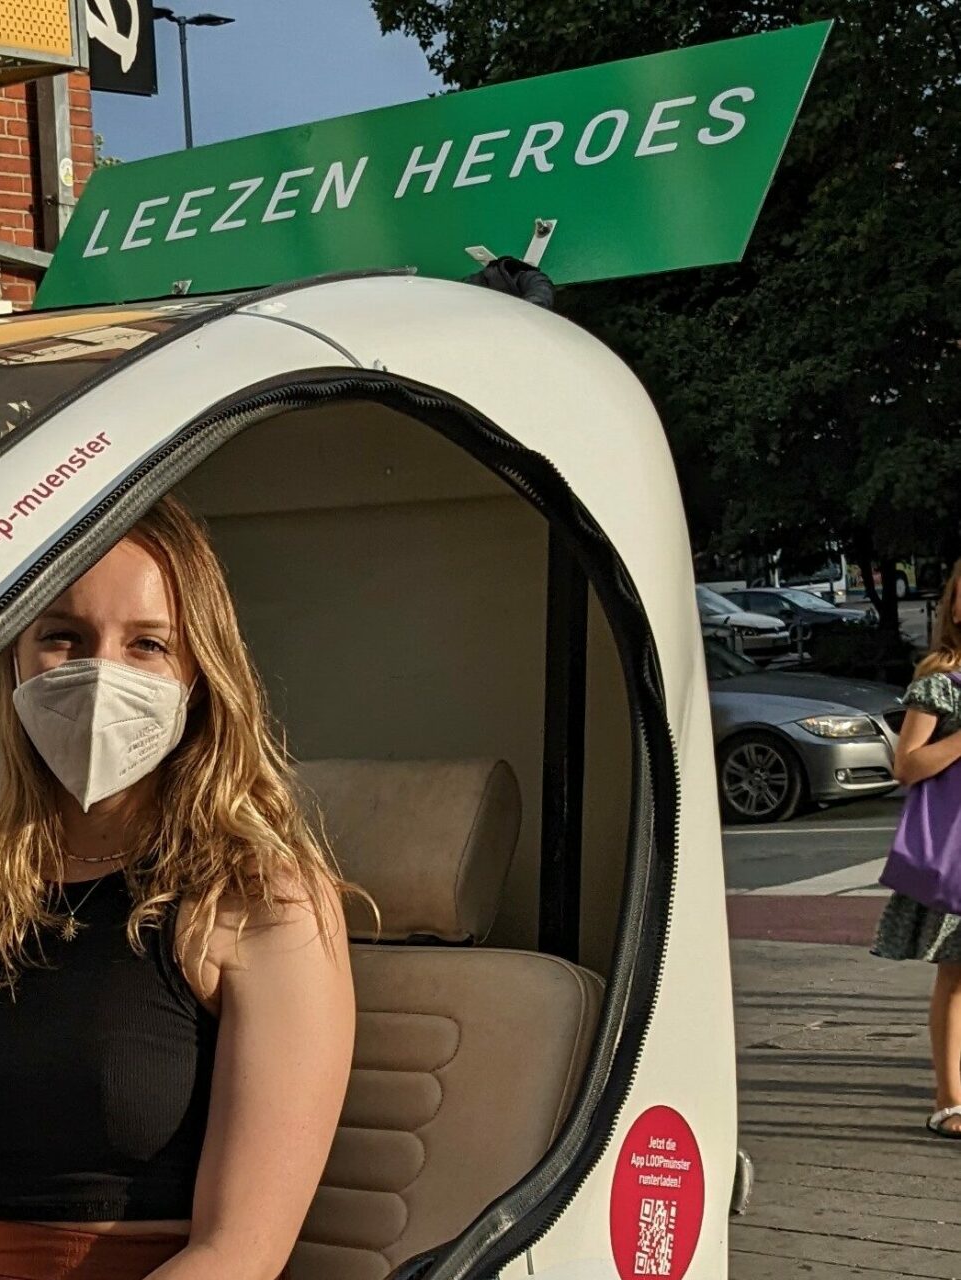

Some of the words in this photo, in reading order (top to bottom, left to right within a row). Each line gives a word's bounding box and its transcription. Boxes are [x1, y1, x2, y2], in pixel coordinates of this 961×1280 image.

[82, 156, 369, 258] LEEZEN
[393, 87, 755, 198] HEROES
[648, 1136, 665, 1150] Jetzt
[665, 1138, 677, 1151] die
[630, 1152, 645, 1169] App
